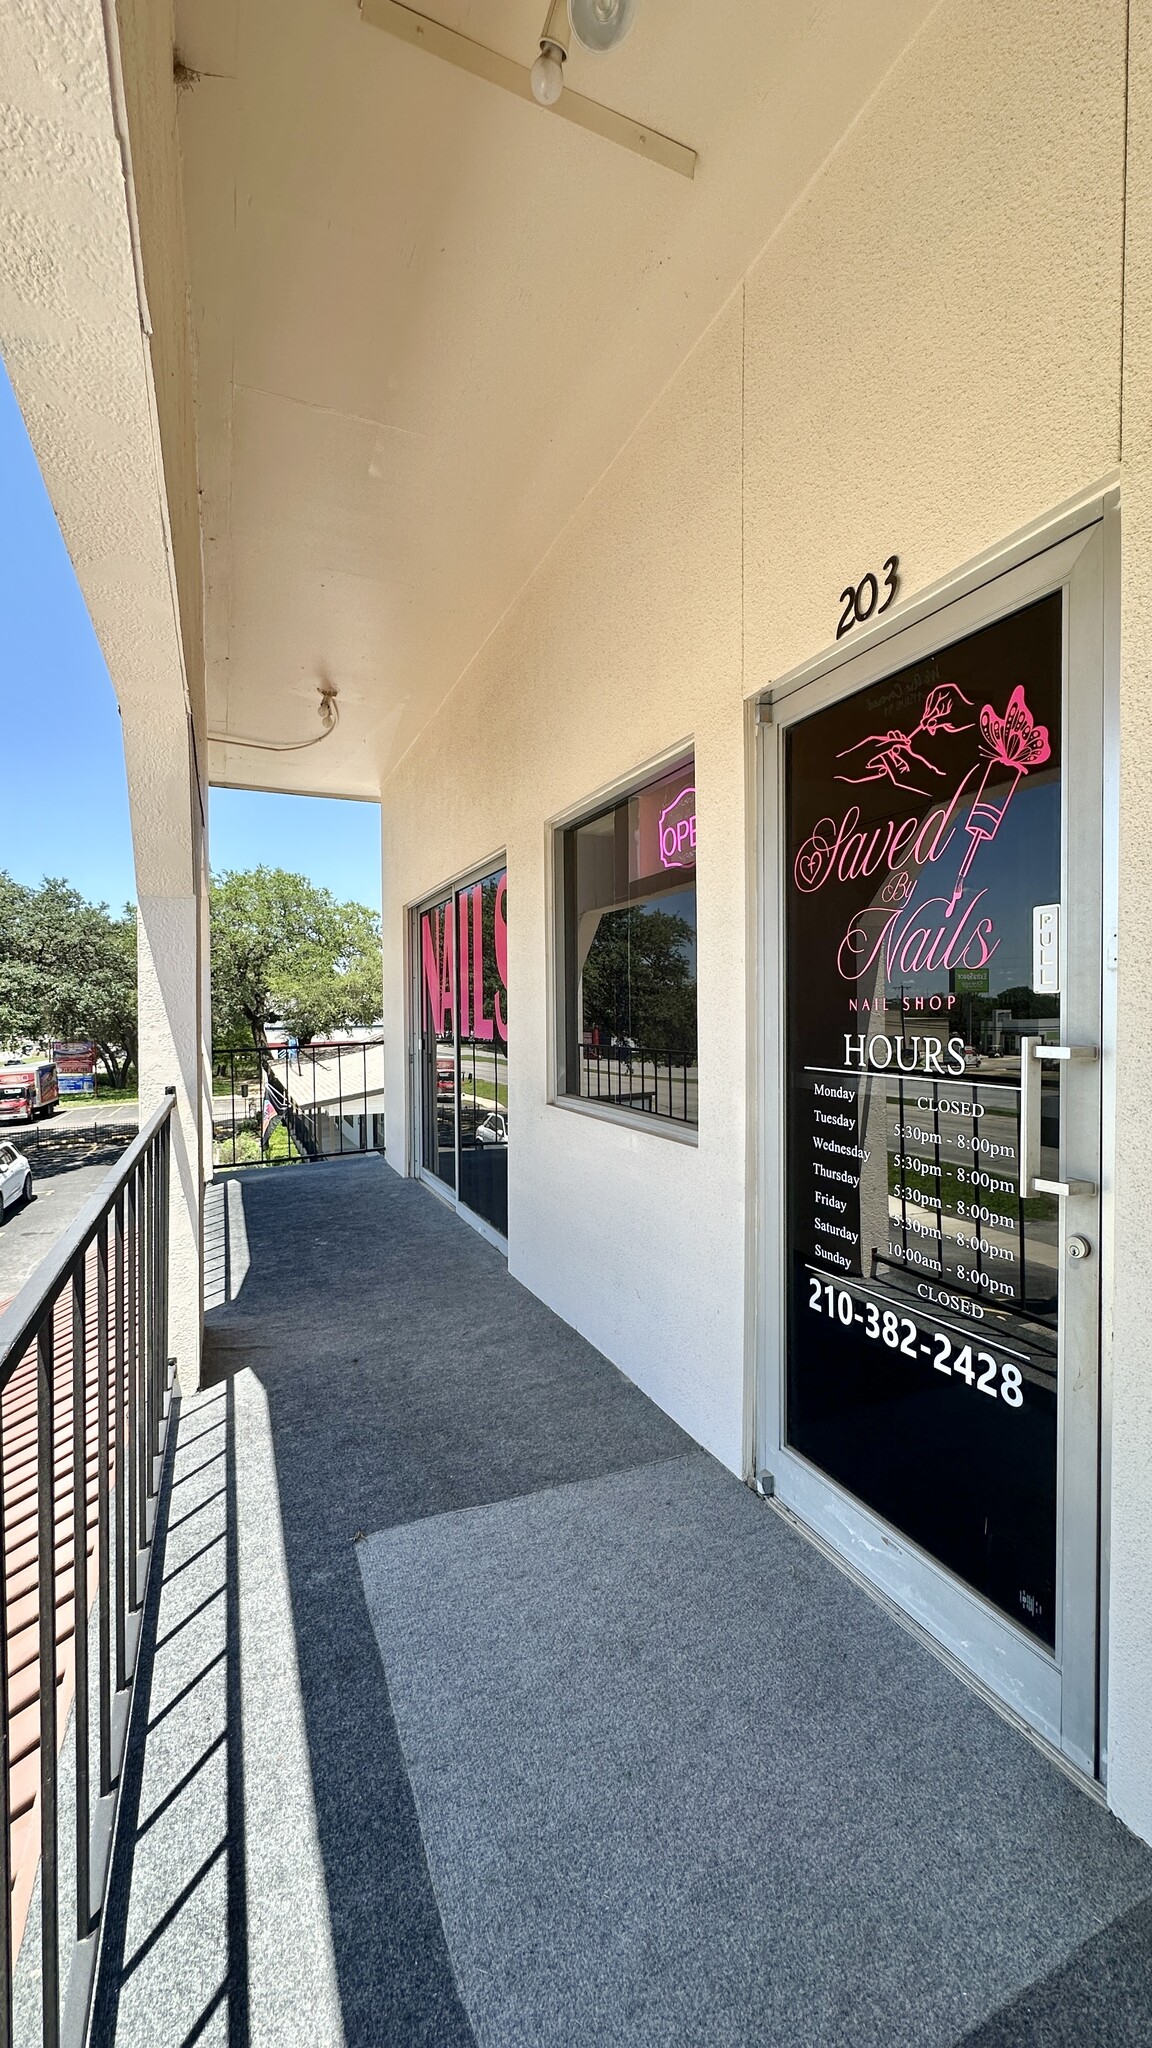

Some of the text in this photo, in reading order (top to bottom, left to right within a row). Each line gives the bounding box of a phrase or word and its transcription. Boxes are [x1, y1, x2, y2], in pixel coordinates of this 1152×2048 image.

[836, 555, 900, 640] 203
[662, 815, 697, 856] OPE
[794, 763, 980, 893] Saved
[882, 872, 917, 907] By
[837, 888, 1001, 983] Nails
[1040, 913, 1054, 985] PULL
[848, 995, 957, 1012] NAIL SHOP
[843, 1034, 966, 1075] HOURS
[814, 1083, 855, 1102] Monday
[917, 1096, 985, 1118] CLOSED
[814, 1109, 856, 1130] Tuesday
[812, 1136, 871, 1162] Wednesday
[893, 1123, 942, 1145] 5:30pm
[957, 1134, 1015, 1158] 8:00pm
[813, 1162, 860, 1188] Thursday
[893, 1154, 942, 1177] 5:30pm
[957, 1167, 1015, 1194] 8:00pm
[815, 1191, 847, 1213] Friday
[893, 1184, 942, 1208] 5:30pm
[957, 1200, 1015, 1229] 8:00pm
[814, 1217, 859, 1244] Saturday
[893, 1213, 942, 1239] 5:30pm
[956, 1231, 1015, 1262] 8:00pm
[815, 1244, 852, 1270] Sunday
[888, 1242, 942, 1272] 10:00am
[956, 1264, 1015, 1297] 8:00pm
[917, 1283, 984, 1319] CLOSED
[809, 1278, 1024, 1408] 210-382-2428
